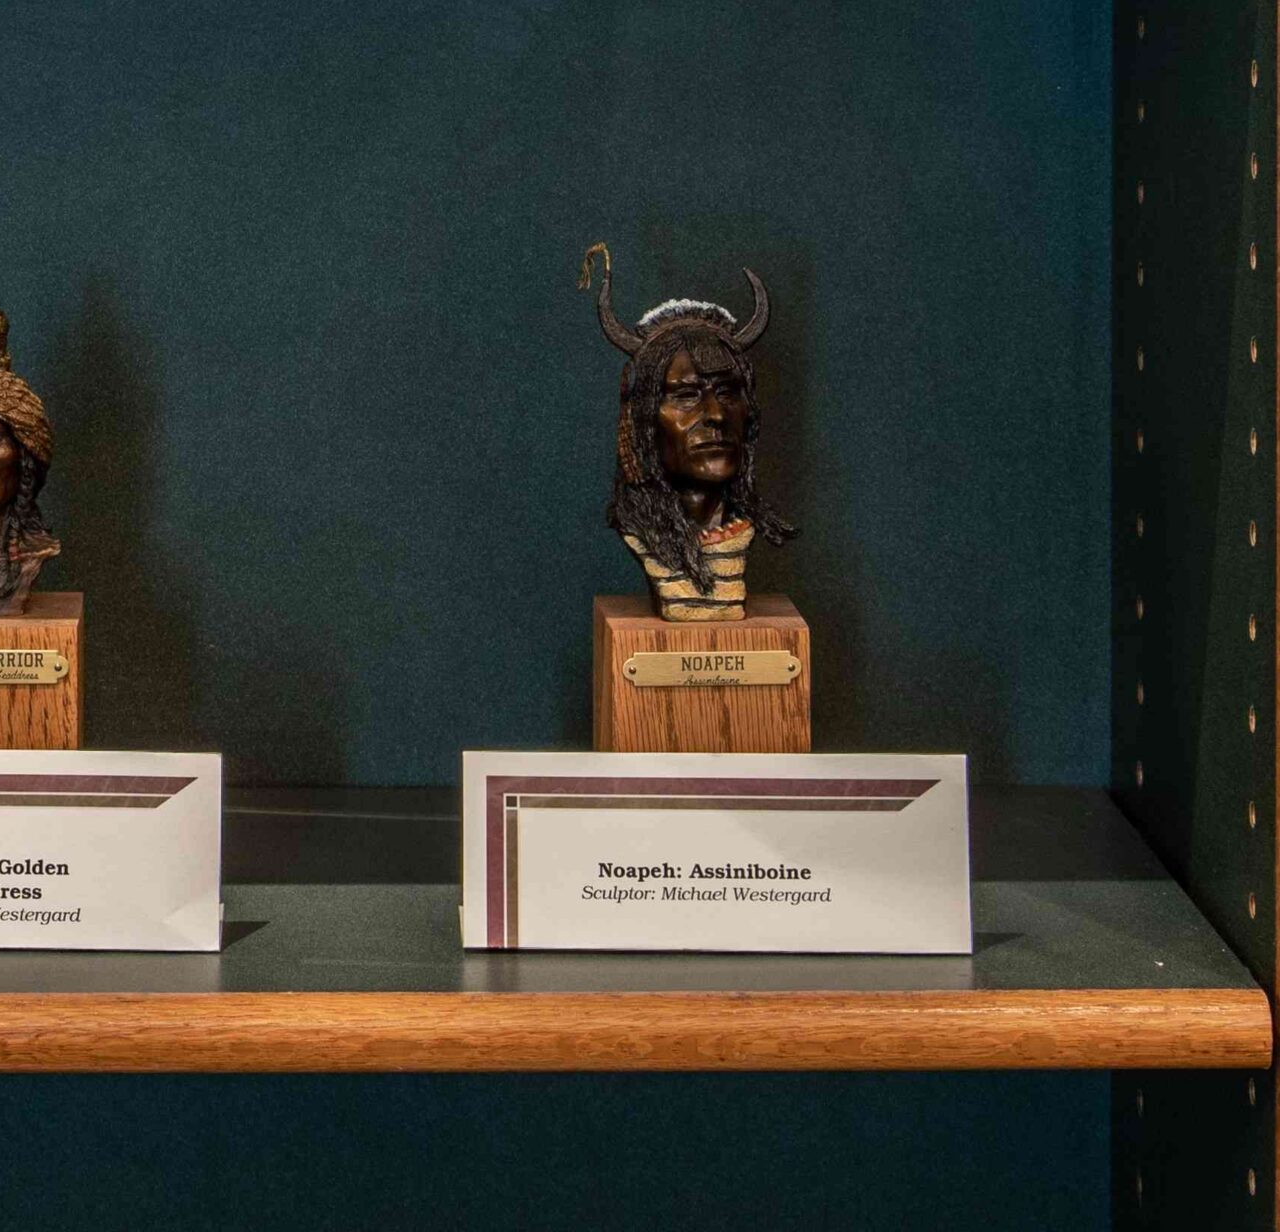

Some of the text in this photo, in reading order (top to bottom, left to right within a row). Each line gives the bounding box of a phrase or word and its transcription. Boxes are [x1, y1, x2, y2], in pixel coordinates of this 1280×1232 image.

[681, 655, 745, 672] NOAPEH
[598, 862, 812, 882] Noapeh: Assiniboine
[581, 885, 832, 905] Sculptor: Michael Westergard
